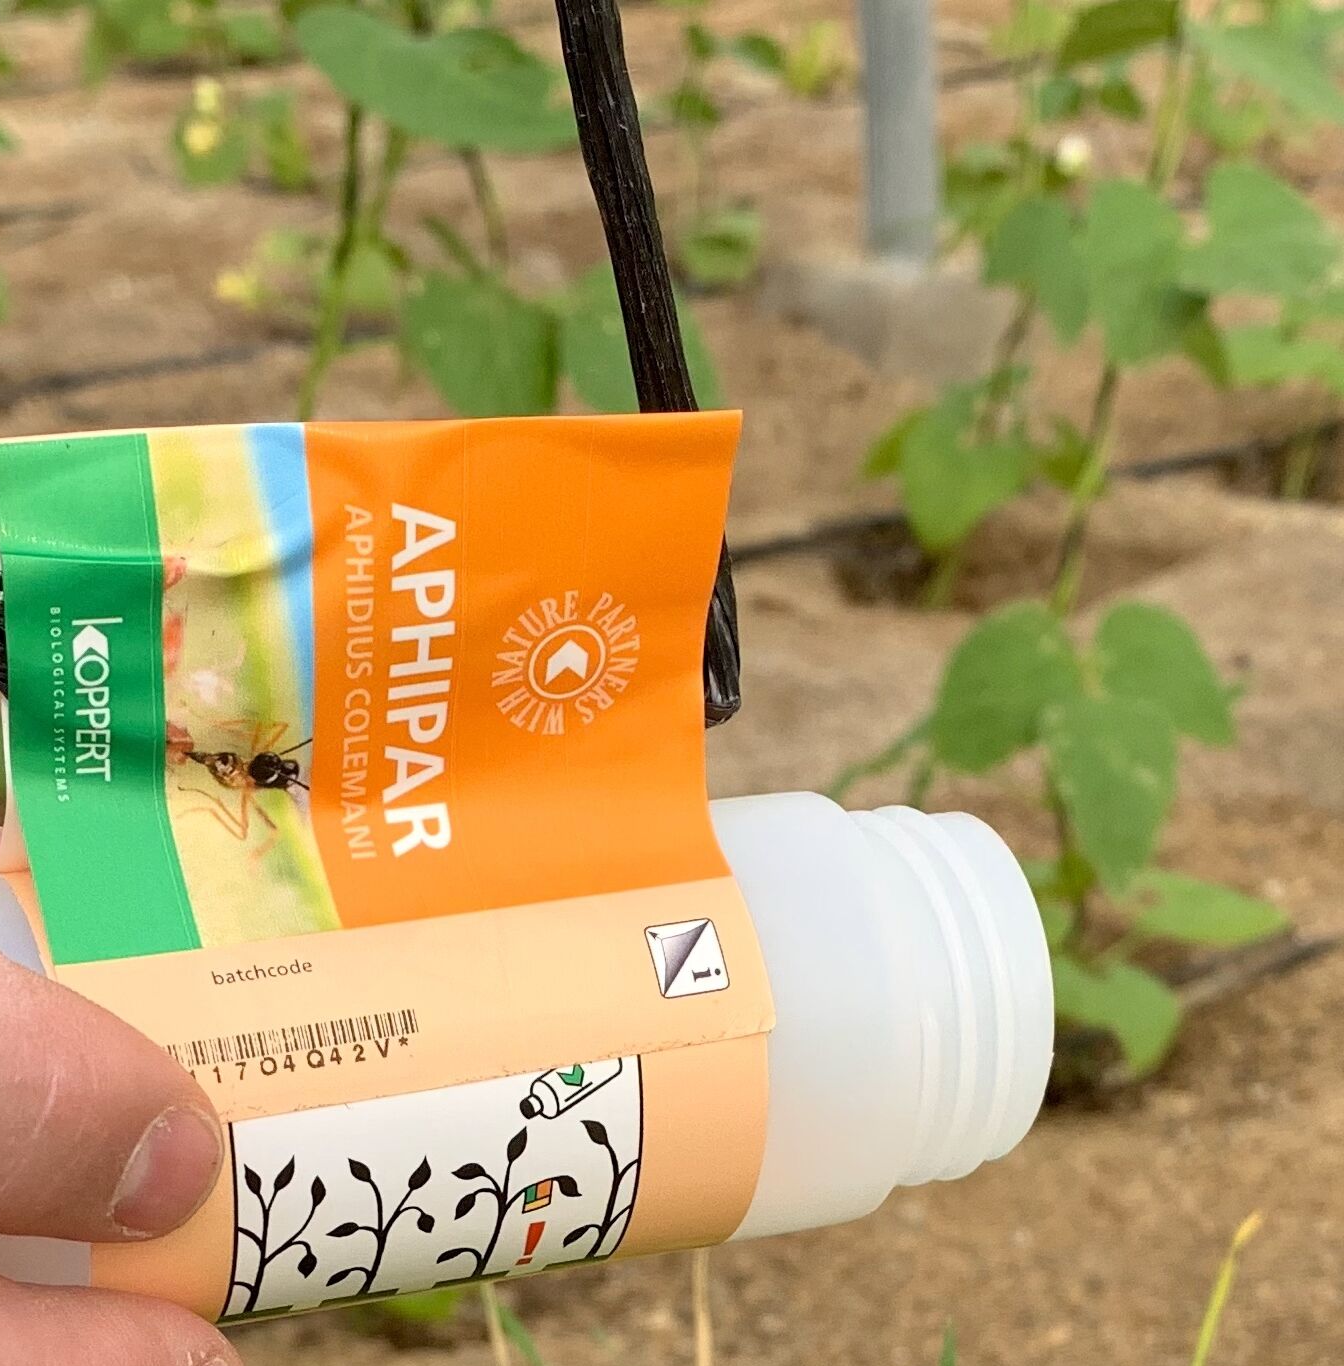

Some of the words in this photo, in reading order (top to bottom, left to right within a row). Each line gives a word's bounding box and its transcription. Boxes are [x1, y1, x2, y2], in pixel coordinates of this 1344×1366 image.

[343, 504, 375, 679] APHIDIUS
[491, 589, 580, 688] NATURE
[50, 606, 65, 719] BIOLOGICAL
[71, 617, 123, 782] KOPPERT
[382, 502, 456, 858] APHIPAR
[495, 686, 566, 736] WITH
[574, 591, 641, 725] PARTNERS
[53, 728, 69, 802] SYSTEMS
[340, 688, 378, 860] COLEMANI
[211, 959, 313, 985] batchcode
